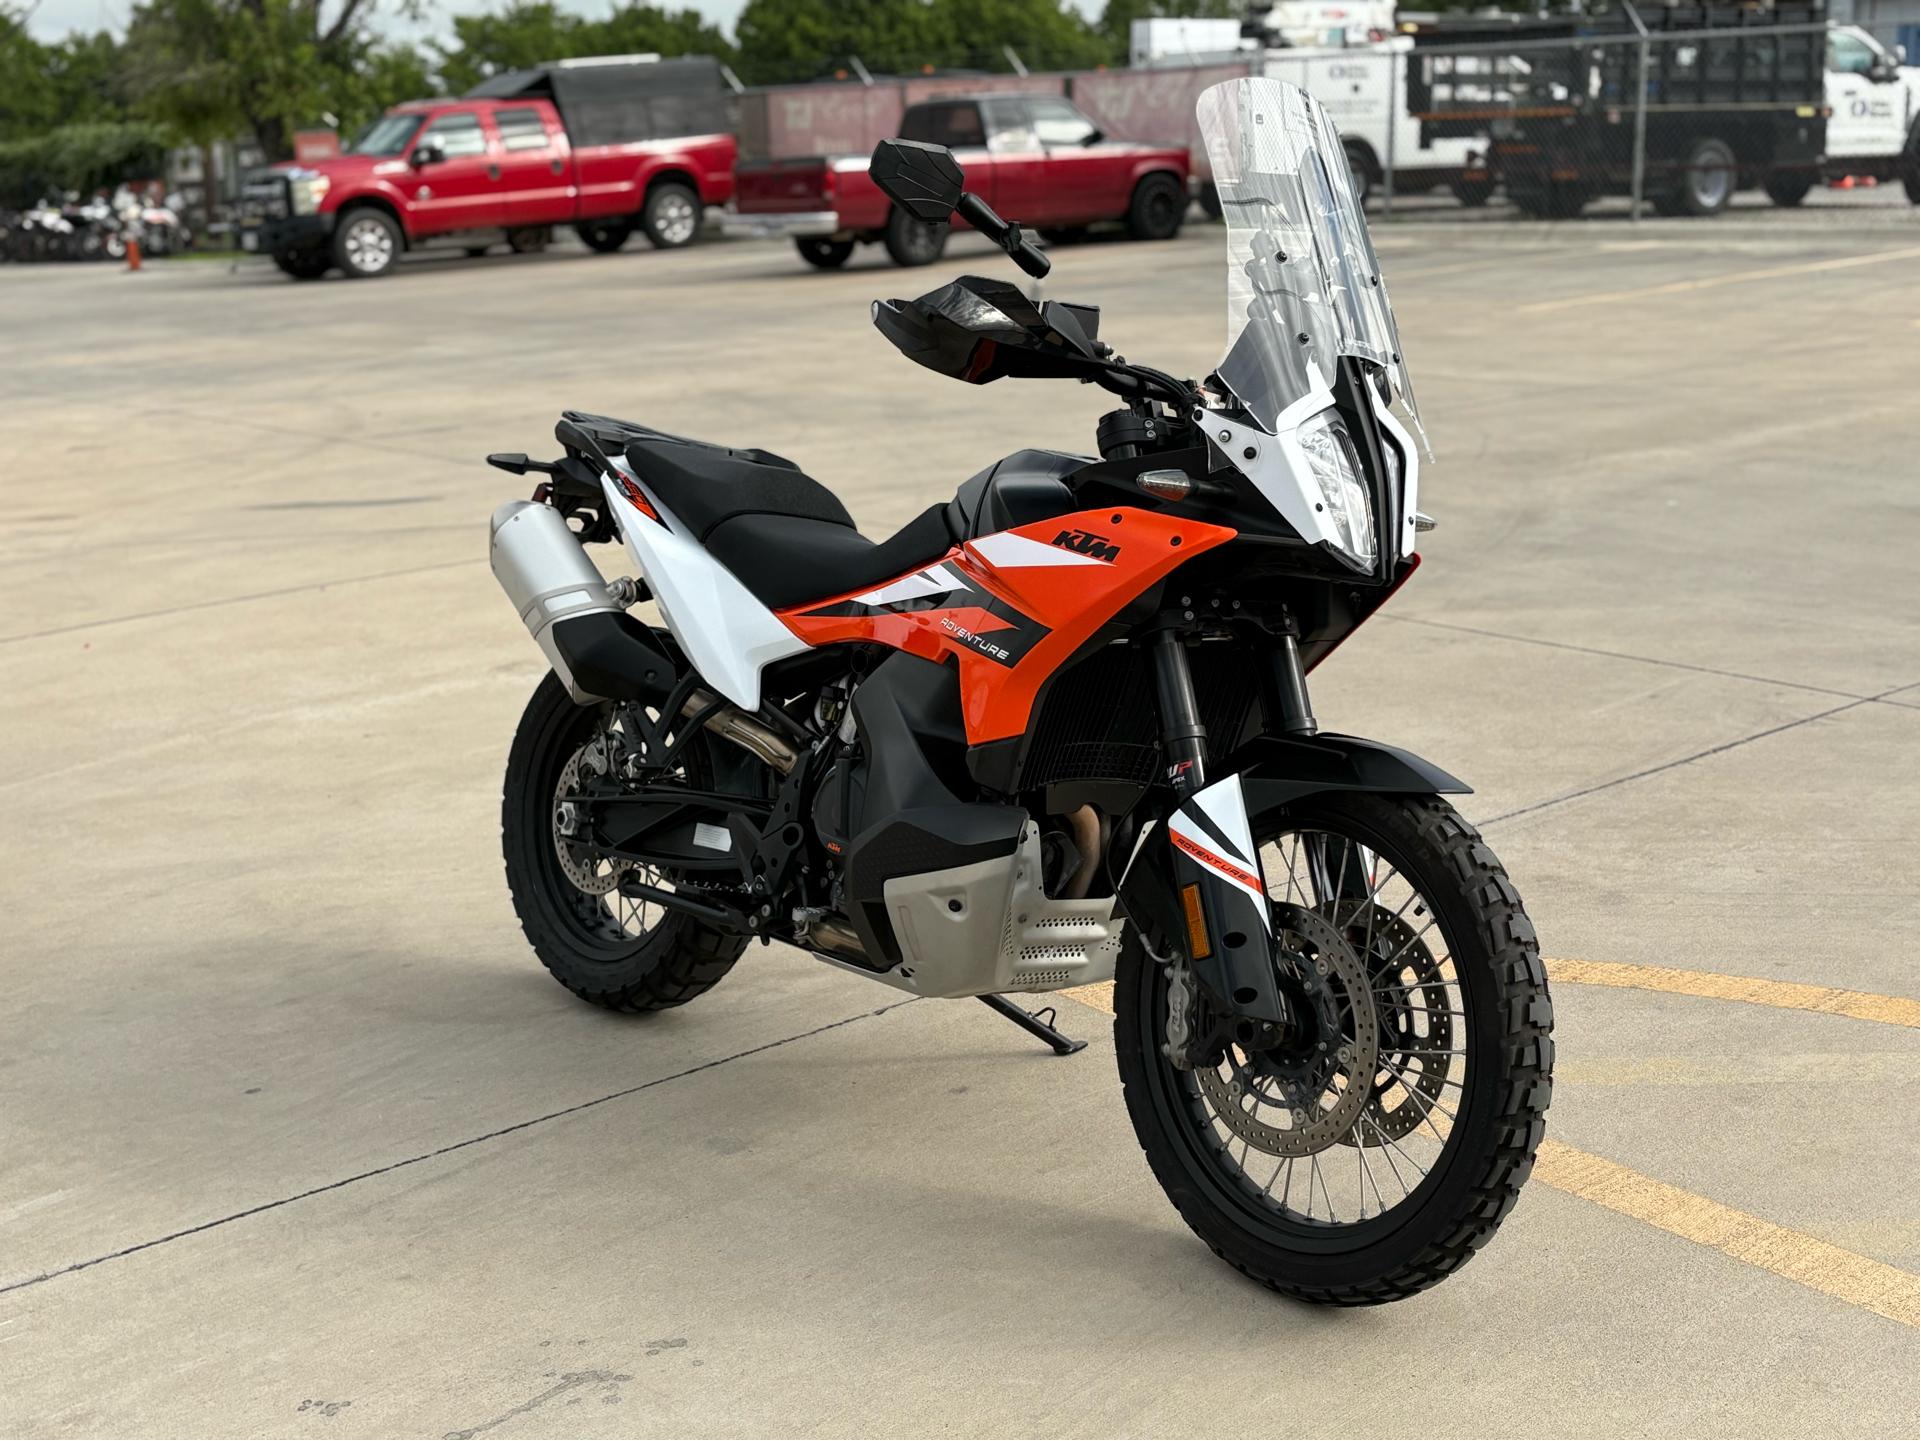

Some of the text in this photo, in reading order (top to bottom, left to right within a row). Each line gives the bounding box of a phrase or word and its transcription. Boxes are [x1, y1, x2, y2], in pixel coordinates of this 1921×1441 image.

[1051, 528, 1121, 563] KTM
[941, 617, 1010, 660] ADVENTURE
[827, 842, 841, 853] KTM
[1176, 838, 1249, 881] ADVENTURE
[1172, 995, 1183, 1033] KTM
